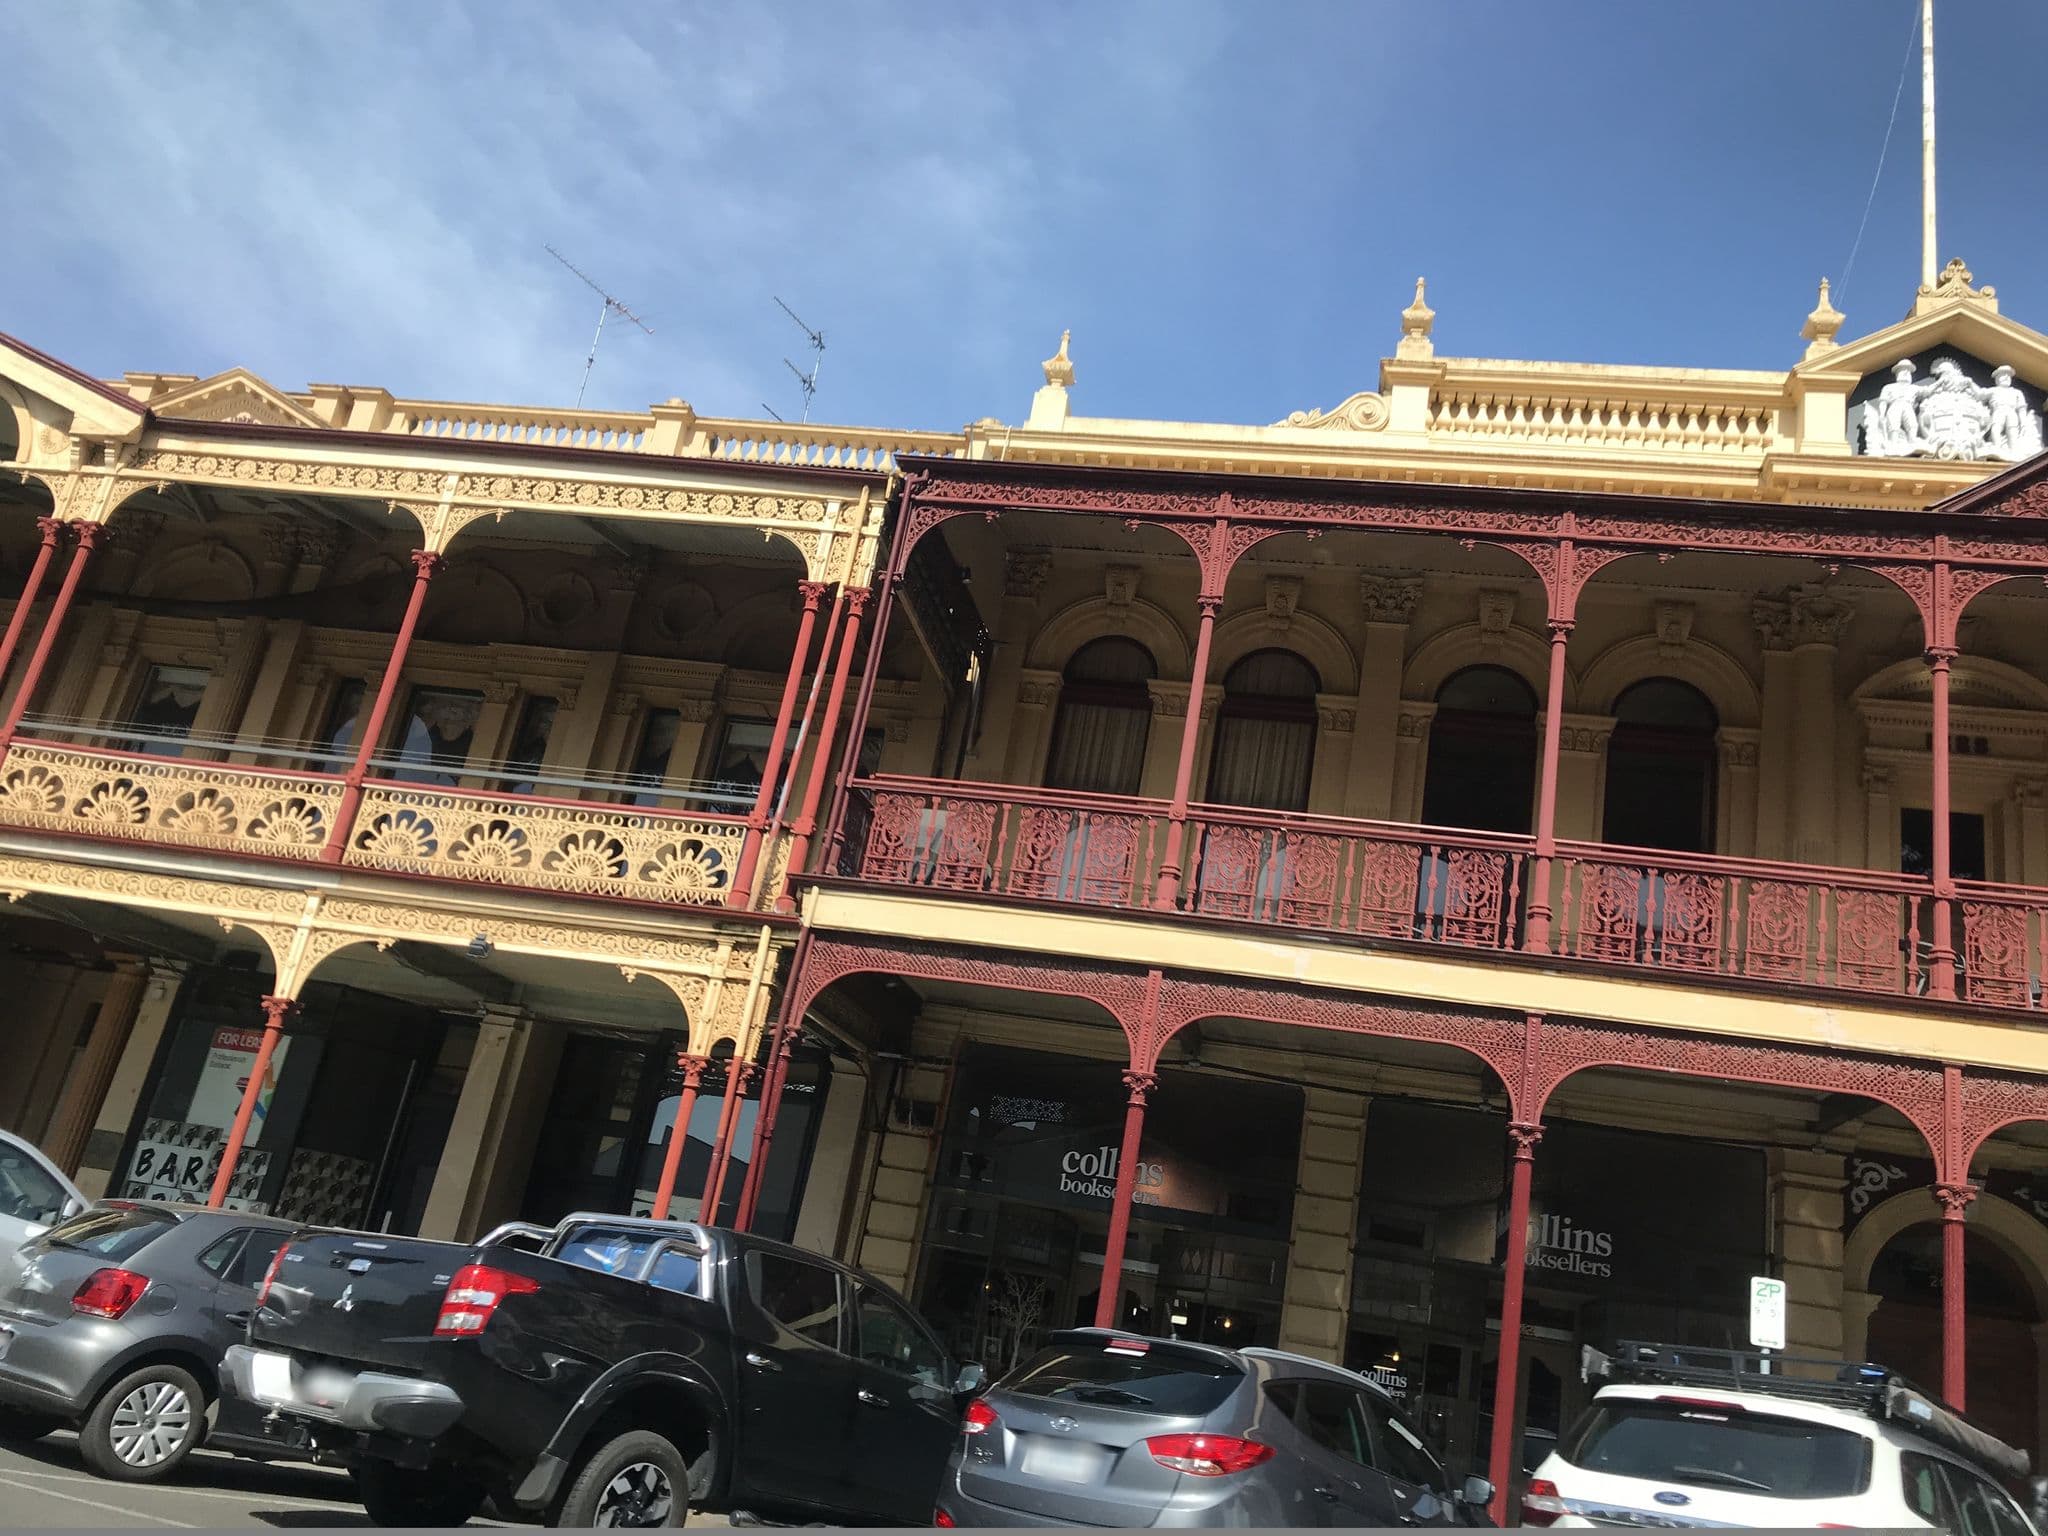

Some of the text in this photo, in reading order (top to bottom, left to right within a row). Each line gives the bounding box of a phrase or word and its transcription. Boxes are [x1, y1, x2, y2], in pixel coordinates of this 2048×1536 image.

[217, 1032, 240, 1046] FOR
[134, 1147, 204, 1186] BAR
[1061, 1145, 1164, 1188] collns
[1059, 1173, 1160, 1207] bookseers
[1526, 1213, 1613, 1257] ollins
[1524, 1248, 1612, 1278] oksellers
[1756, 1281, 1781, 1298] 2P
[1359, 1368, 1408, 1388] collins
